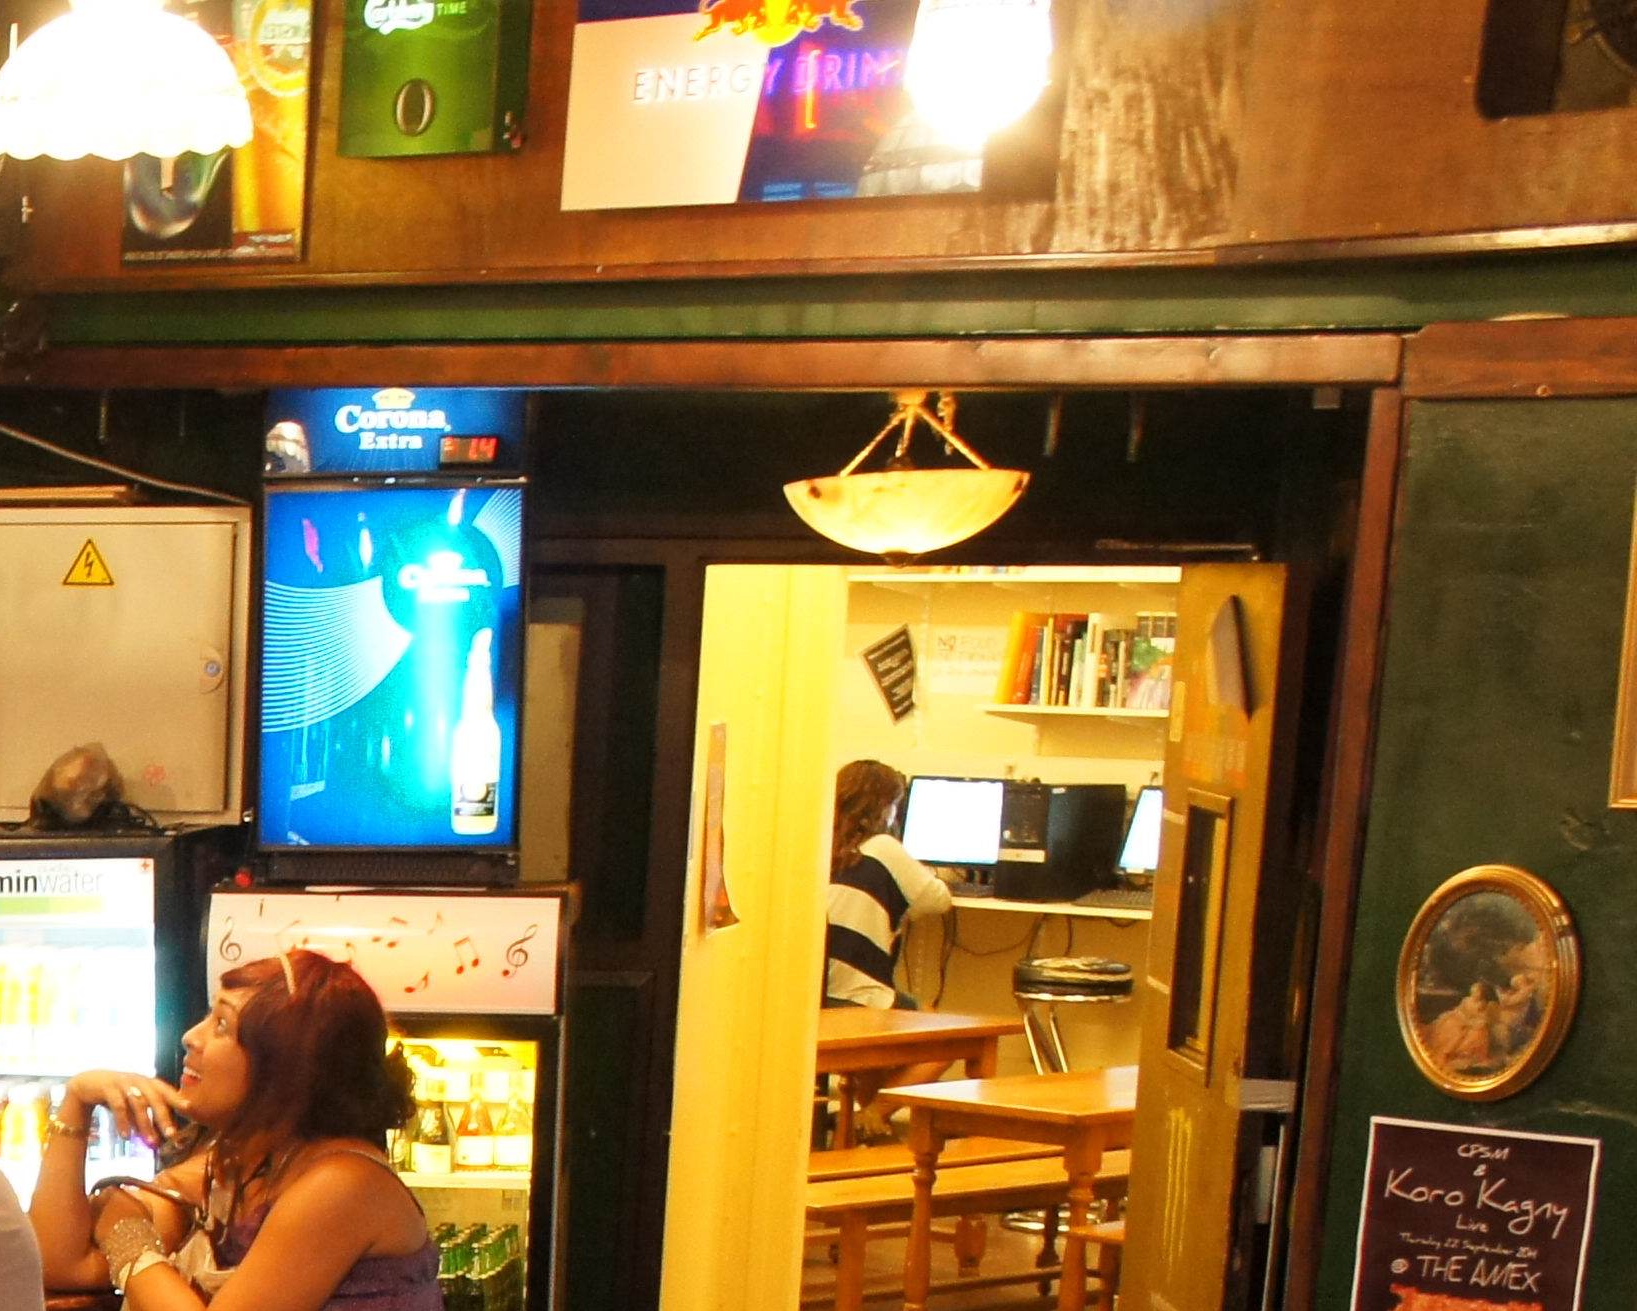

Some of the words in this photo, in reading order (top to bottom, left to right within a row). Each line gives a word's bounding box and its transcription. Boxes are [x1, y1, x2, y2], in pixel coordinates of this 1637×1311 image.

[436, 2, 467, 16] TIME
[633, 57, 784, 104] ENERGY
[793, 48, 906, 93] DRIN
[335, 404, 446, 434] Corona
[358, 431, 423, 450] Extra
[1384, 1167, 1465, 1206] Koro
[1476, 1177, 1569, 1239] Kagny
[1455, 1213, 1490, 1233] Live
[1416, 1254, 1468, 1283] THE
[1469, 1258, 1542, 1293] AMEX
